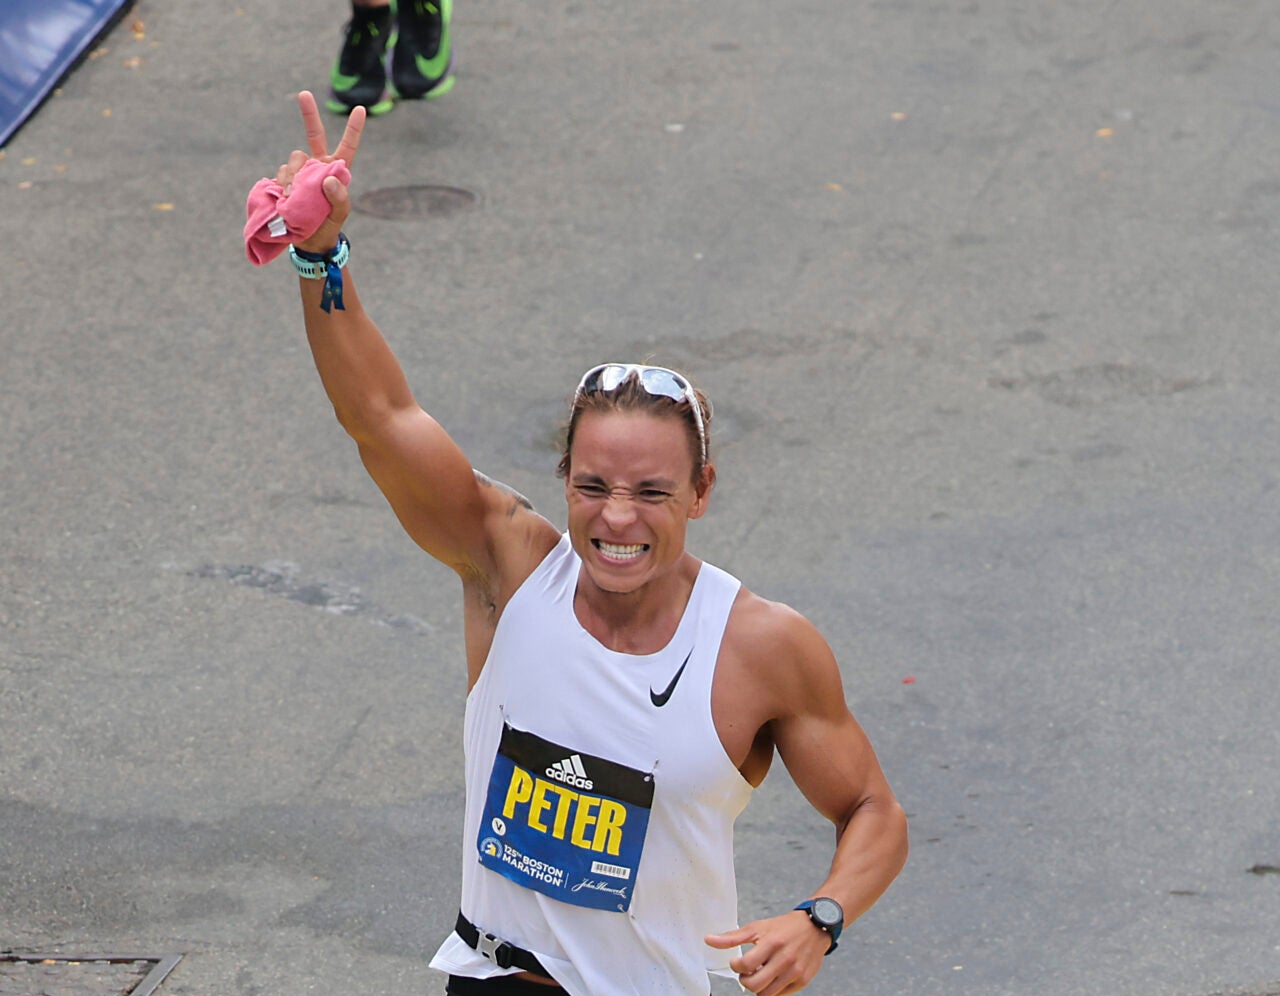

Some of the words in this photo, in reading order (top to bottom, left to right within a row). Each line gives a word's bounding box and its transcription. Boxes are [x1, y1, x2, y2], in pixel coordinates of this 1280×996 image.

[545, 766, 594, 790] adidas
[502, 765, 628, 857] PETER
[523, 855, 564, 878] BOSTON
